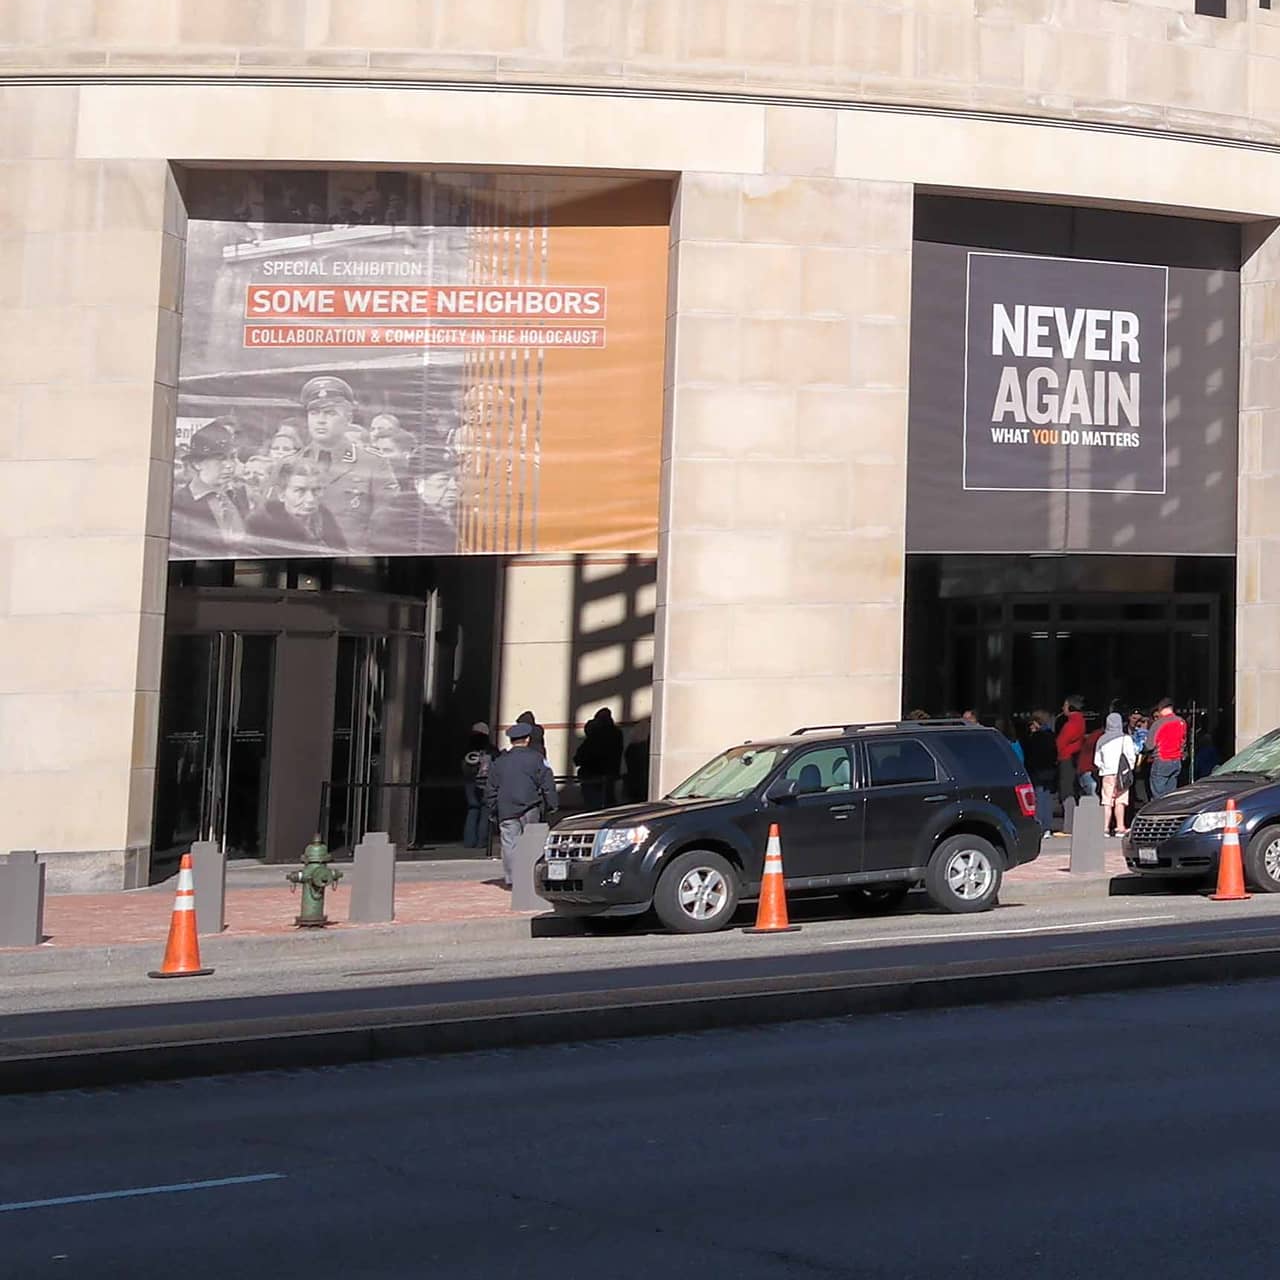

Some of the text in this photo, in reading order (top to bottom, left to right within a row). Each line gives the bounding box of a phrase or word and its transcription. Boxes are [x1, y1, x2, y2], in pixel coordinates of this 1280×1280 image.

[263, 260, 422, 276] SPECIAL EXHIBITION
[252, 290, 600, 314] SOME WERE NEIGHBORS
[251, 329, 598, 344] COLLABORATION & COMPLICITY IN THE HOLOCAUST
[992, 303, 1141, 363] NEVER
[991, 366, 1140, 427] AGAIN
[991, 428, 1140, 447] WHAT YOU DO MATTERS
